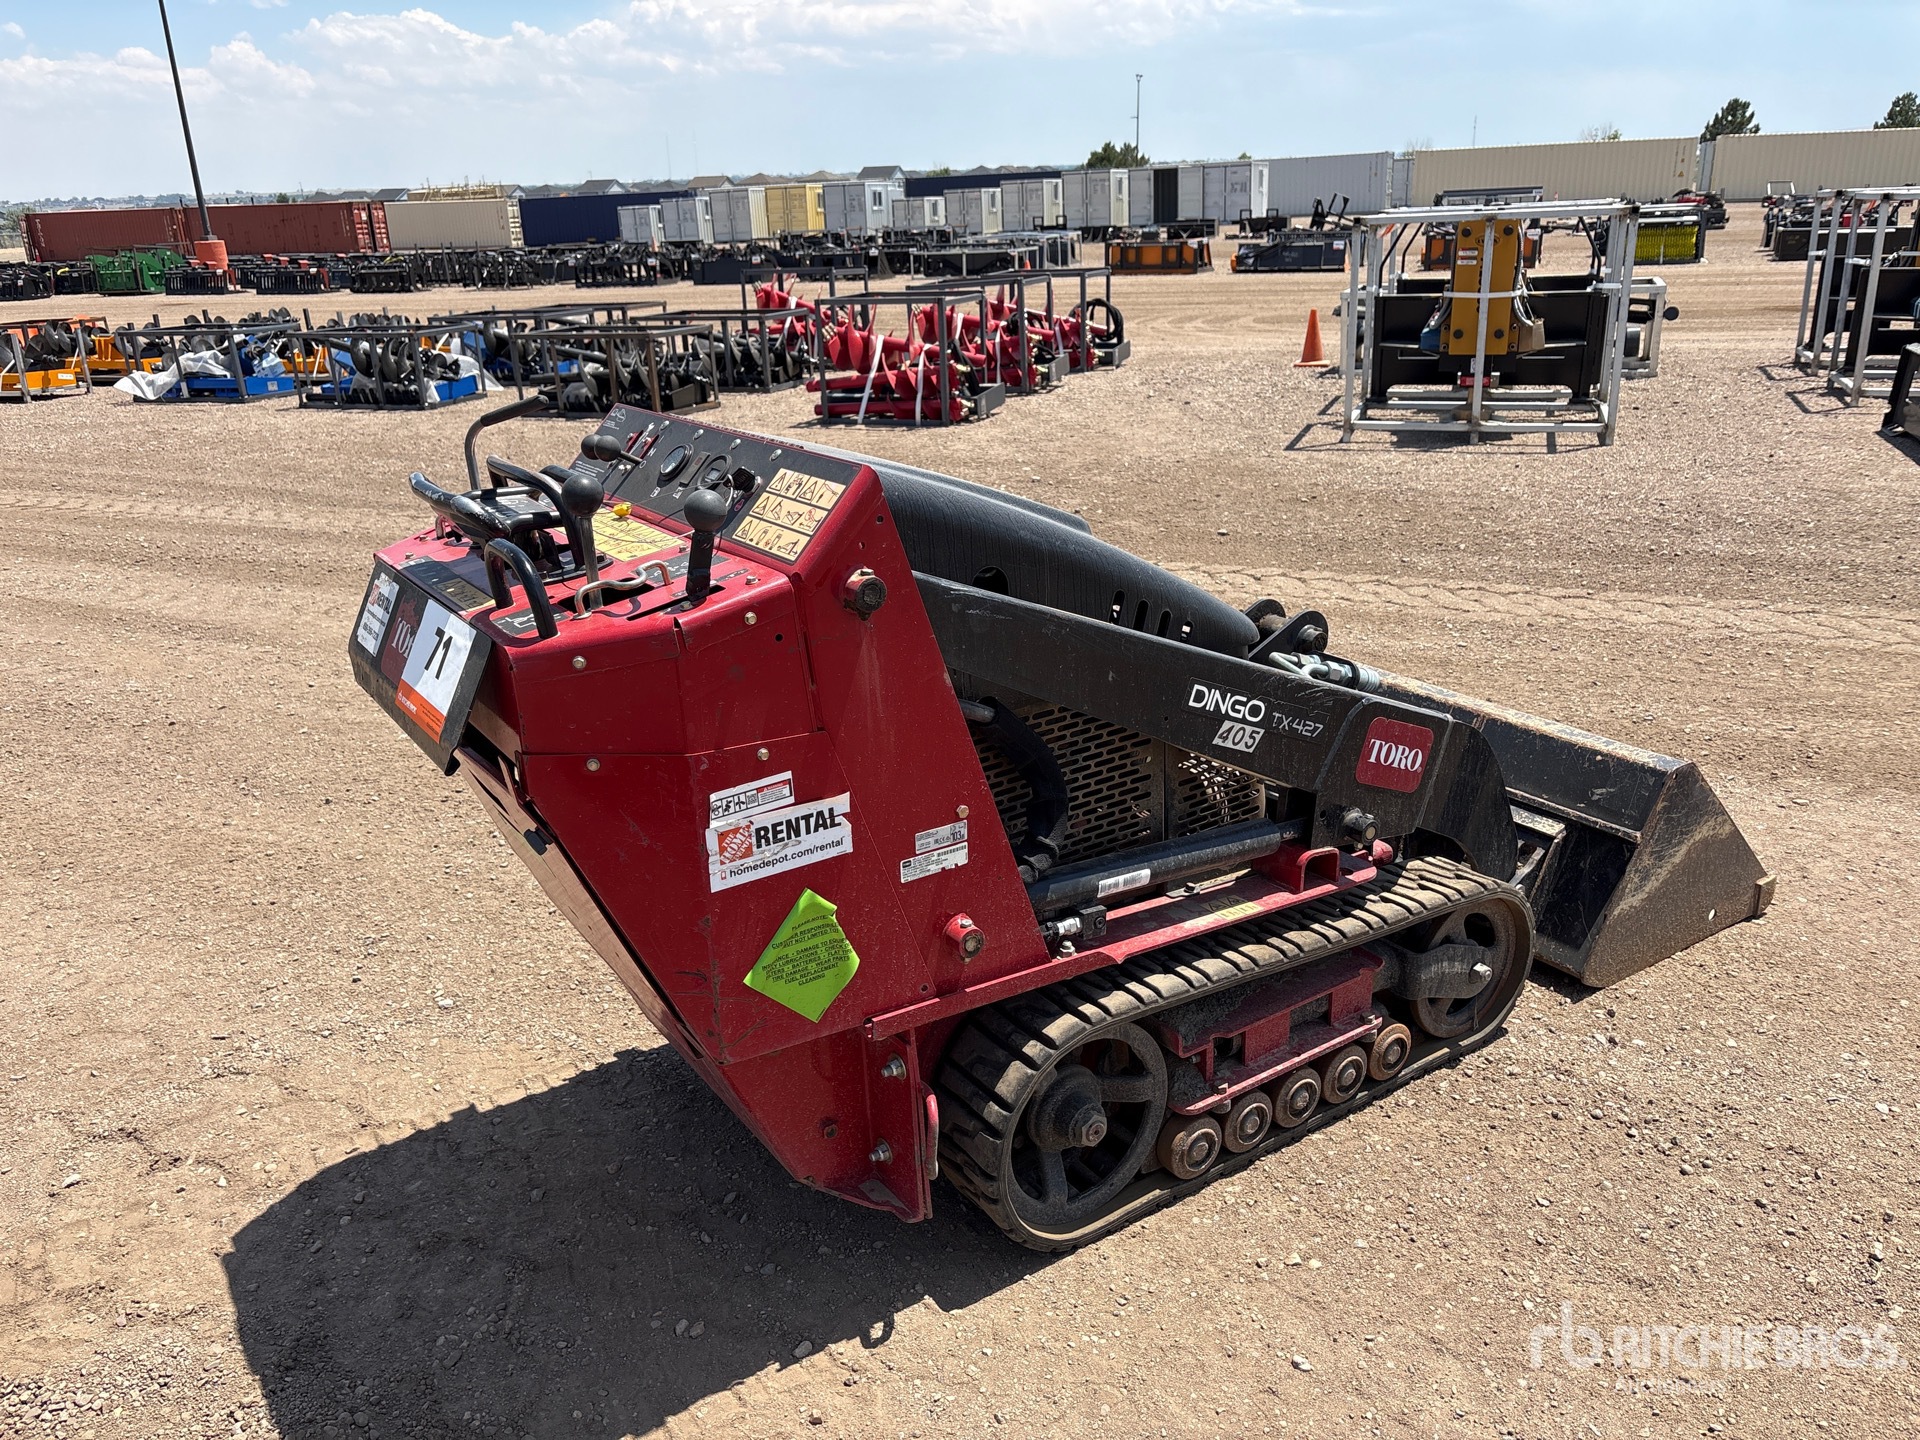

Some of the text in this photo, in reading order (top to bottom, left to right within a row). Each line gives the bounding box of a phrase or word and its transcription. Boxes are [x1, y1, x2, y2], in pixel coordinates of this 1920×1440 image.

[424, 626, 453, 680] 71
[1188, 684, 1265, 722] DINGO
[1217, 724, 1261, 749] 405
[1367, 738, 1423, 772] TORO
[721, 832, 736, 847] THE
[754, 807, 841, 849] RENTAL
[720, 825, 751, 864] HOME
[733, 836, 752, 861] DEPOT
[729, 837, 845, 878] homedepot.com/rental
[791, 955, 821, 969] BATTERIES
[795, 943, 819, 956] DAMAGE
[785, 965, 809, 978] DAMAGE
[815, 958, 832, 967] WEAR
[797, 972, 826, 986] CLEANING
[799, 962, 839, 979] REPLACEMENT
